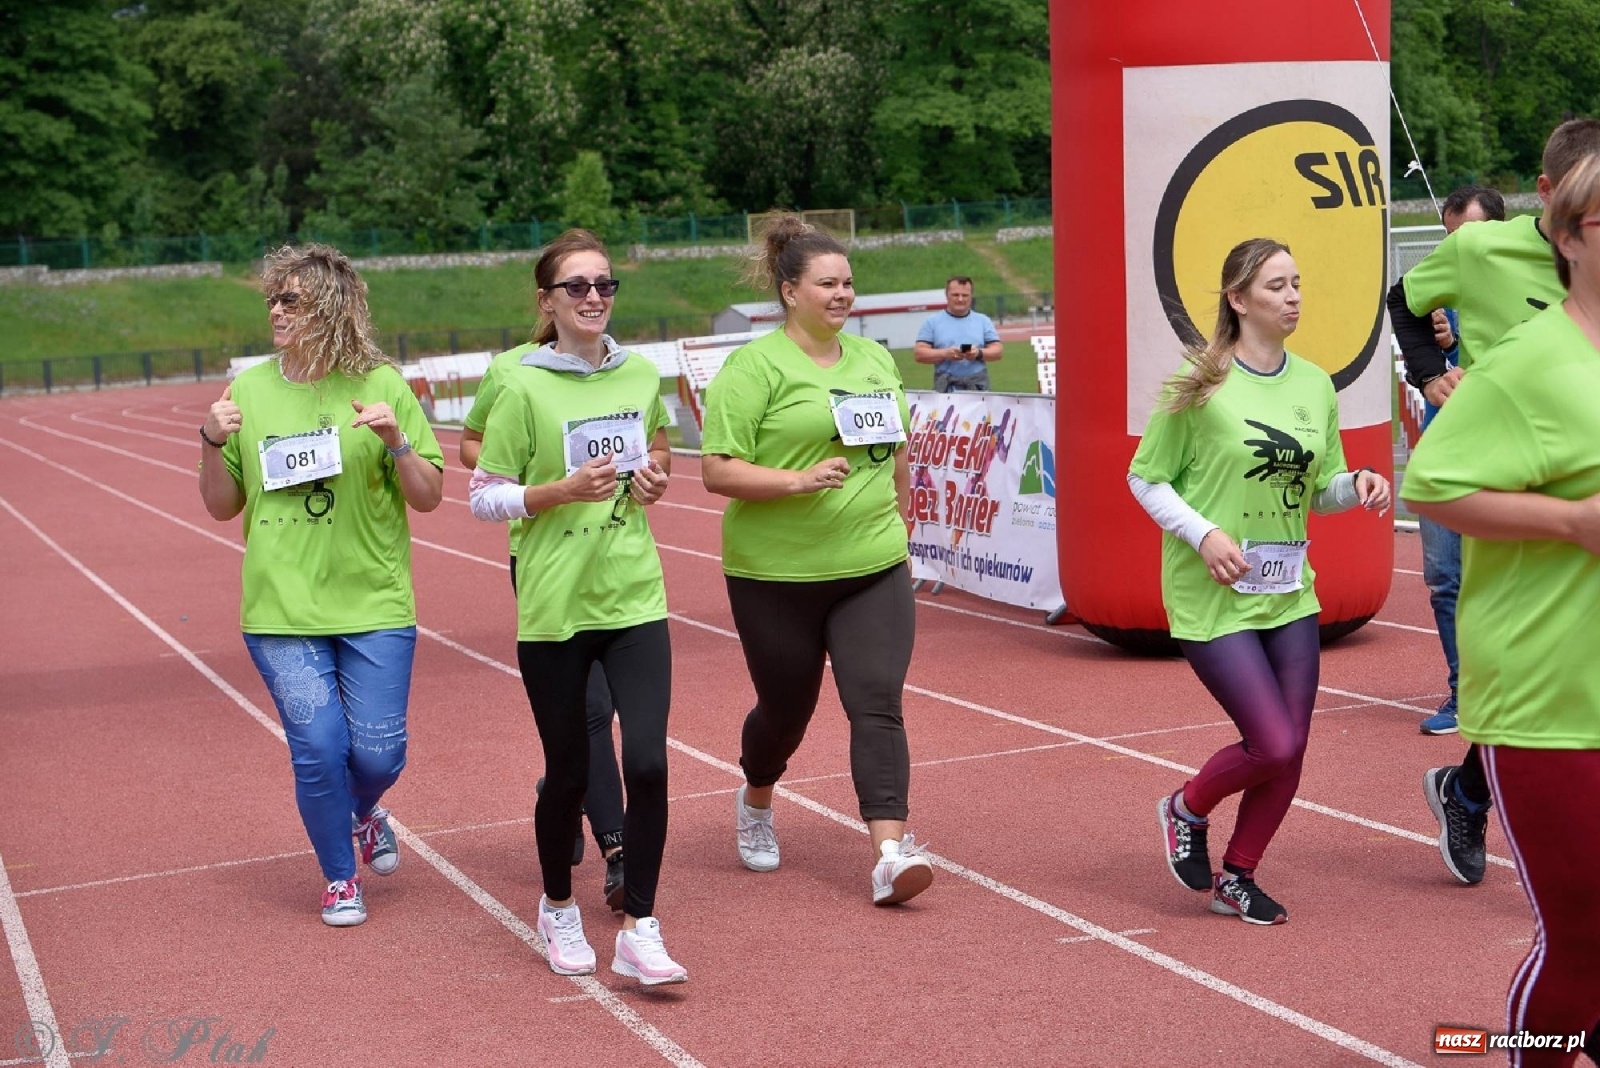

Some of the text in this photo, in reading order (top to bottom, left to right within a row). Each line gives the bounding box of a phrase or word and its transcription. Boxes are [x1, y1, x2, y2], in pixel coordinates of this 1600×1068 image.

[854, 411, 885, 429] 002
[587, 435, 624, 458] 080
[1275, 448, 1295, 462] VII
[286, 449, 316, 470] 081
[945, 480, 999, 535] Barier
[961, 547, 972, 571] ich
[974, 553, 1033, 584] opiekunów
[1261, 560, 1283, 577] 011
